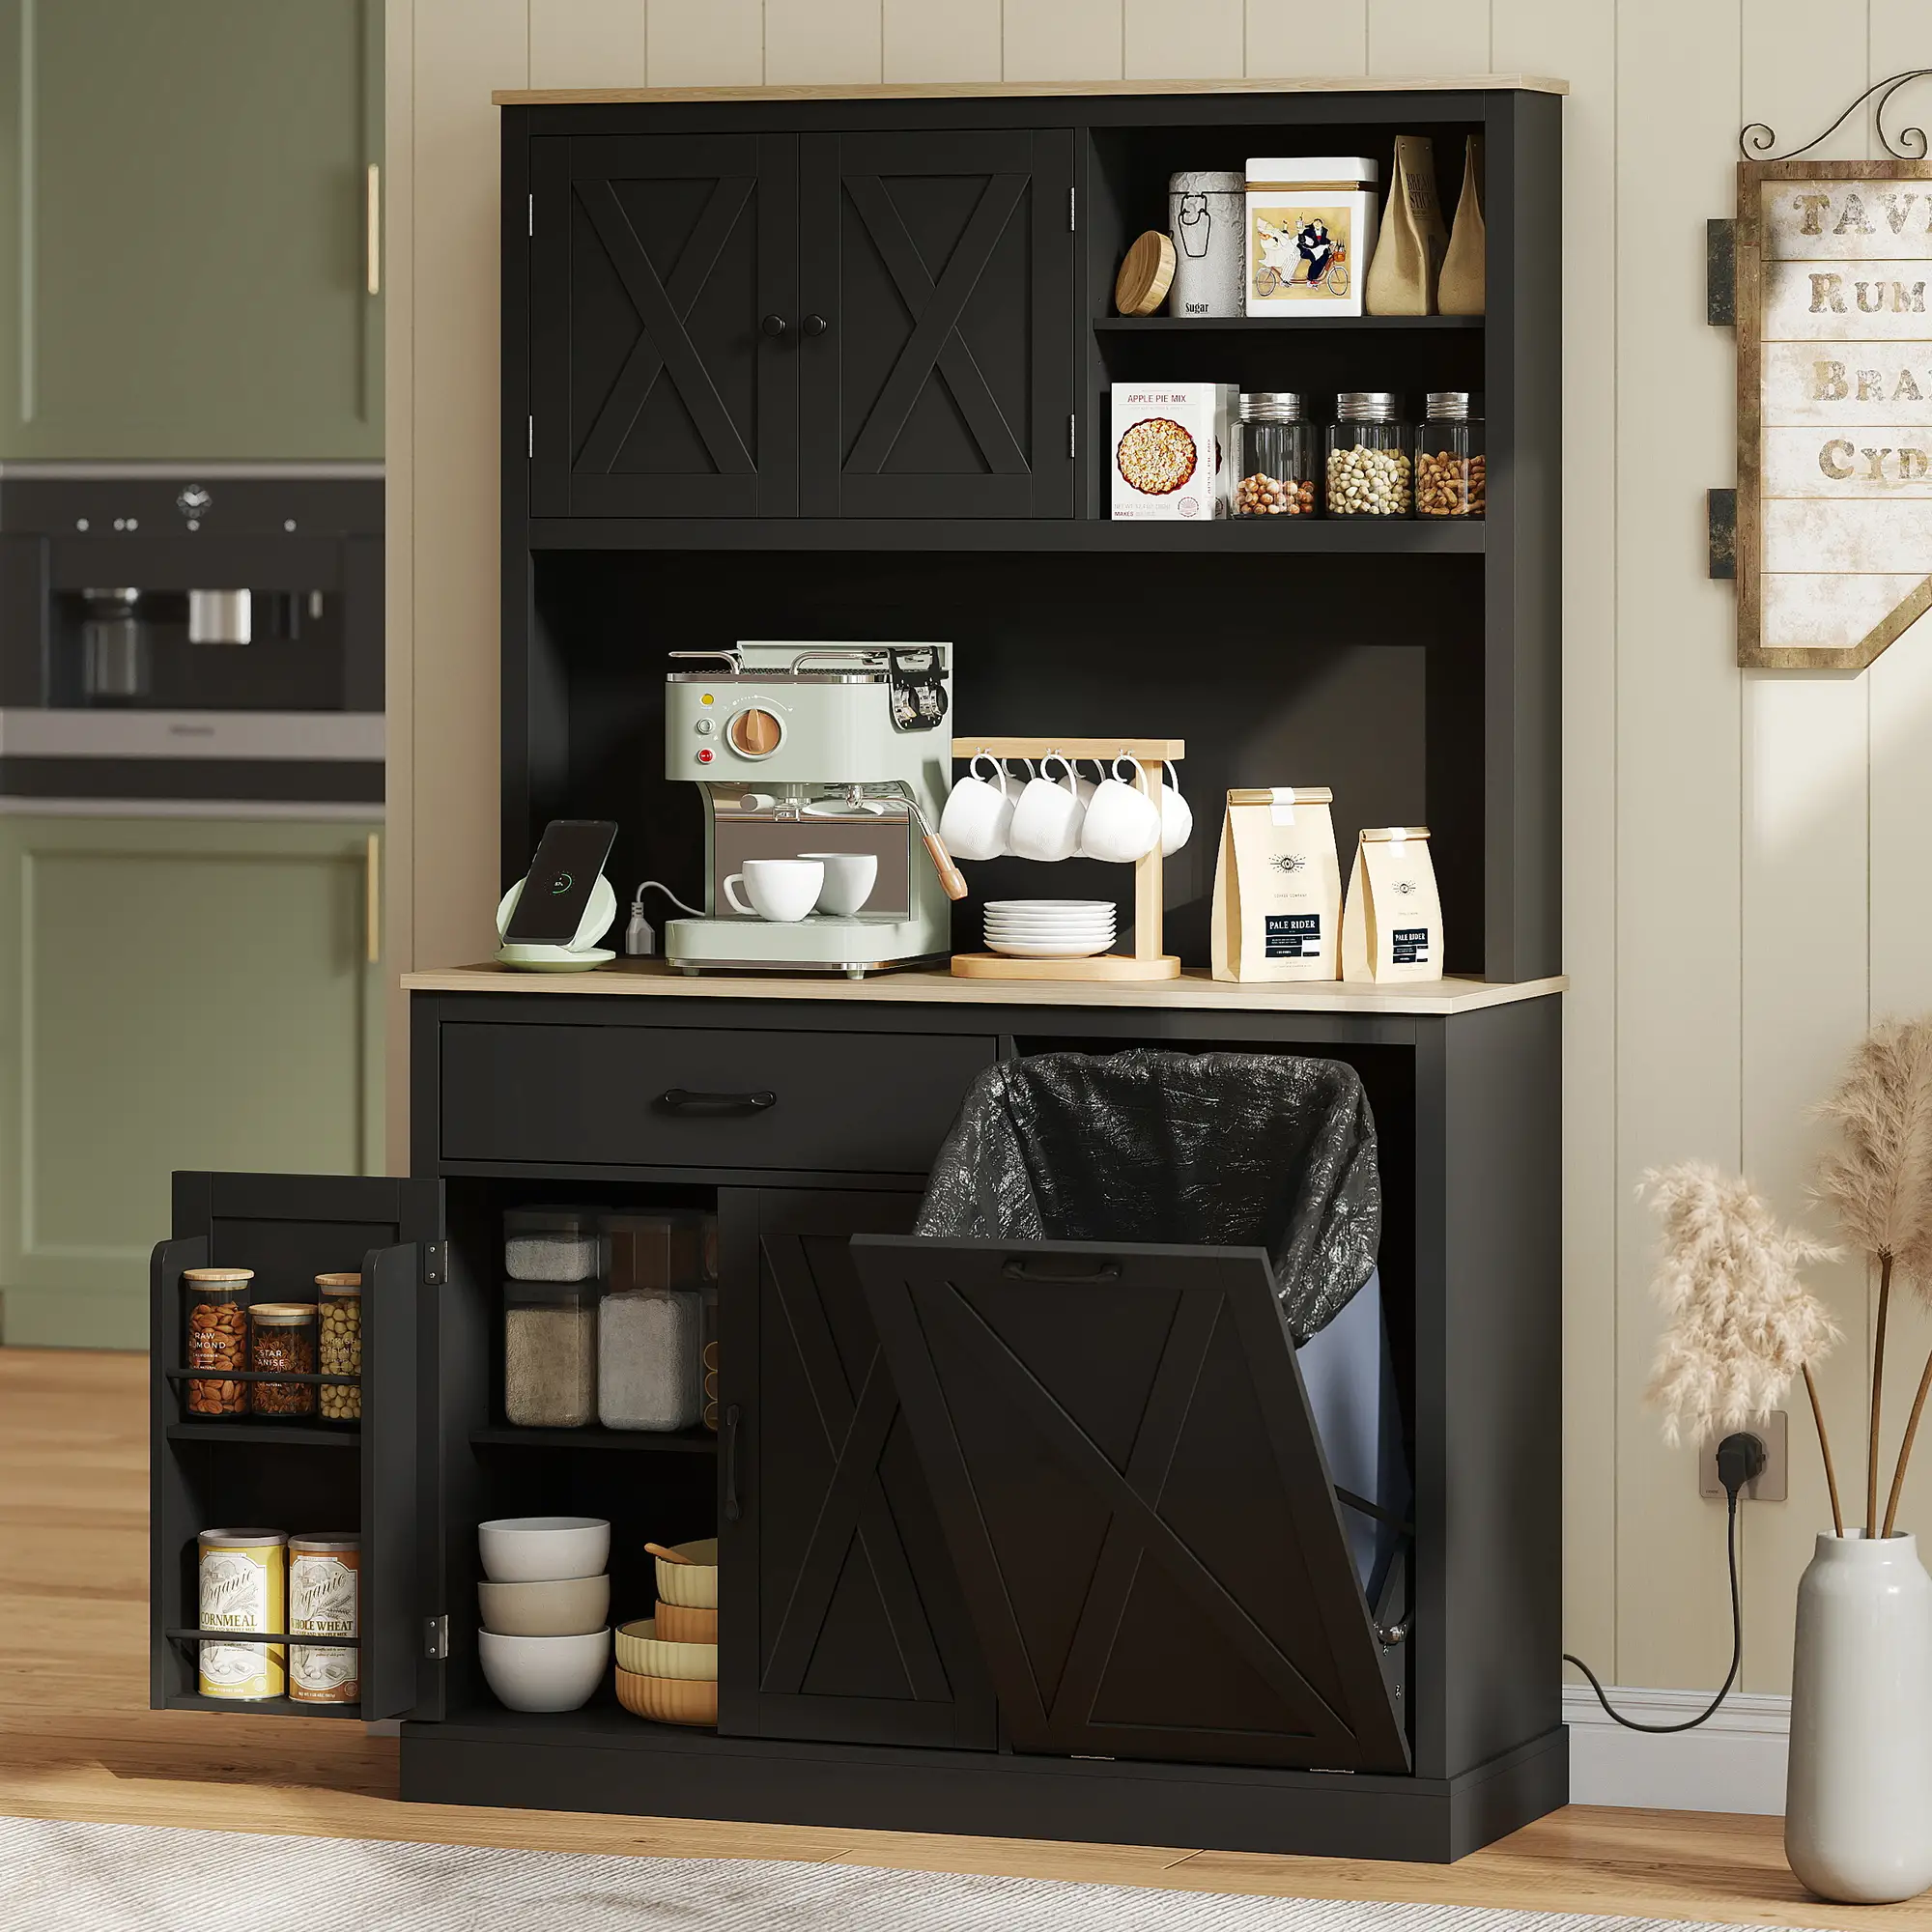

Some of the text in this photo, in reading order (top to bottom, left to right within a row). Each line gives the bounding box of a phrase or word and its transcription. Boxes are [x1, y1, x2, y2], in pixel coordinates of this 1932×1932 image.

[1807, 272, 1926, 313] RUM
[1185, 302, 1209, 314] Sugar
[1812, 360, 1932, 401] BRA
[1127, 394, 1186, 403] APPLE PIE MIX
[1818, 439, 1928, 480] CYD
[1269, 920, 1316, 929] PALE RIDER
[1408, 932, 1426, 941] RIDER
[258, 1358, 285, 1367] ANISE
[200, 1568, 254, 1611] Organic
[292, 1572, 347, 1612] Organic
[200, 1611, 258, 1627] CORNMEAL
[316, 1620, 354, 1631] WHEAT
